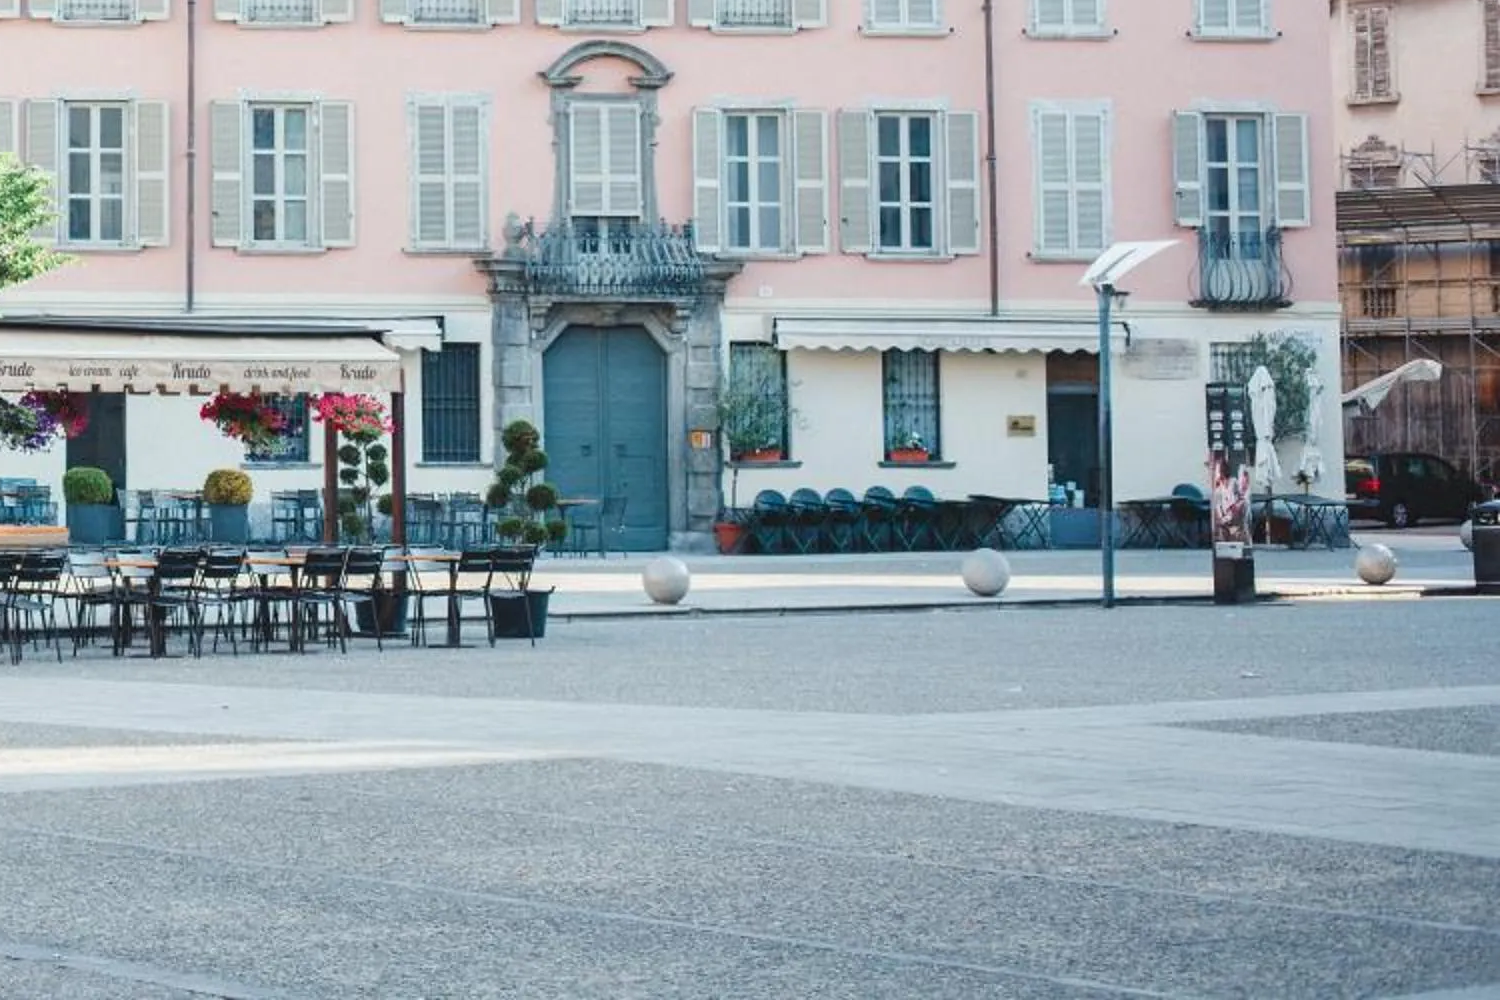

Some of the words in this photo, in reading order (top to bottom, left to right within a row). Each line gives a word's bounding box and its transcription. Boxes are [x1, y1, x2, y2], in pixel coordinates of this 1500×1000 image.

[84, 366, 112, 376] cream
[172, 363, 211, 380] Krudo
[243, 366, 269, 379] drink
[271, 366, 288, 379] and
[288, 366, 311, 381] food
[340, 363, 377, 380] Krudo
